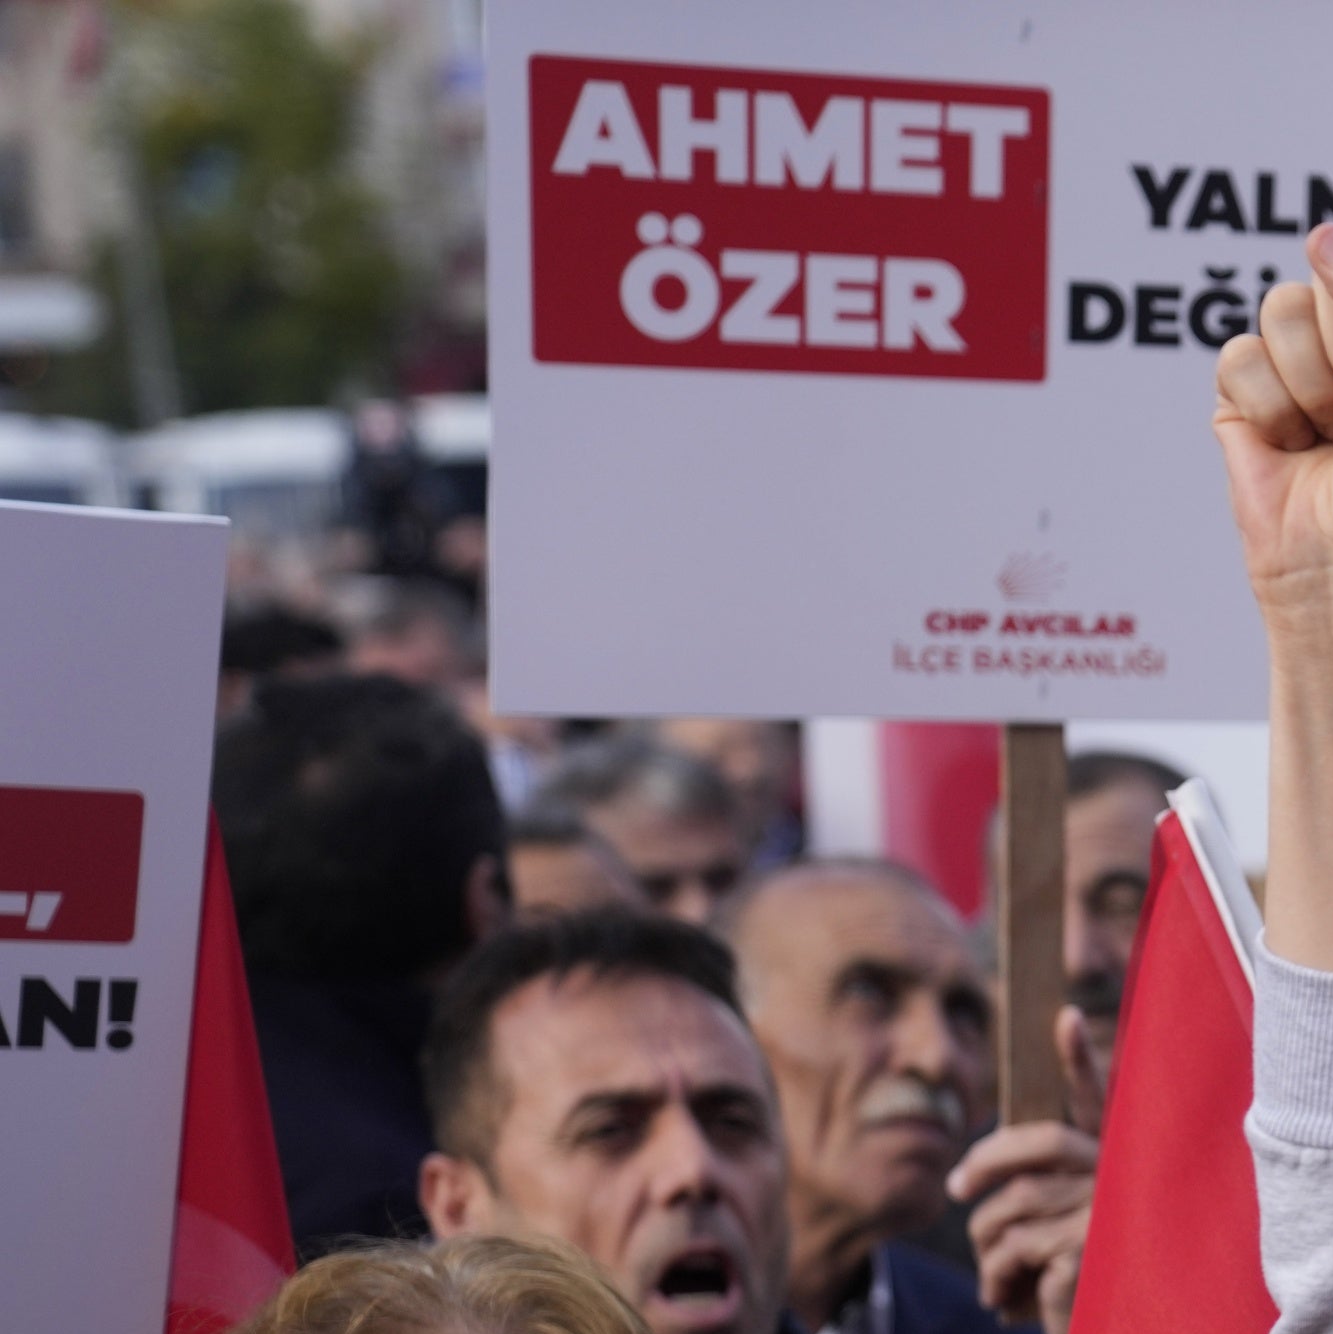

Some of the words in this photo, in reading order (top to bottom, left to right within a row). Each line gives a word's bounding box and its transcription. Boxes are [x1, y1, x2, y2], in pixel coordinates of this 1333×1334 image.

[551, 78, 1032, 200] AHMET
[619, 211, 968, 354] ÖZER
[892, 637, 962, 675] İLÇE
[972, 642, 1167, 678] BAŞKANLIĞI
[924, 610, 990, 635] CHP
[999, 612, 1136, 638] AVCILAR
